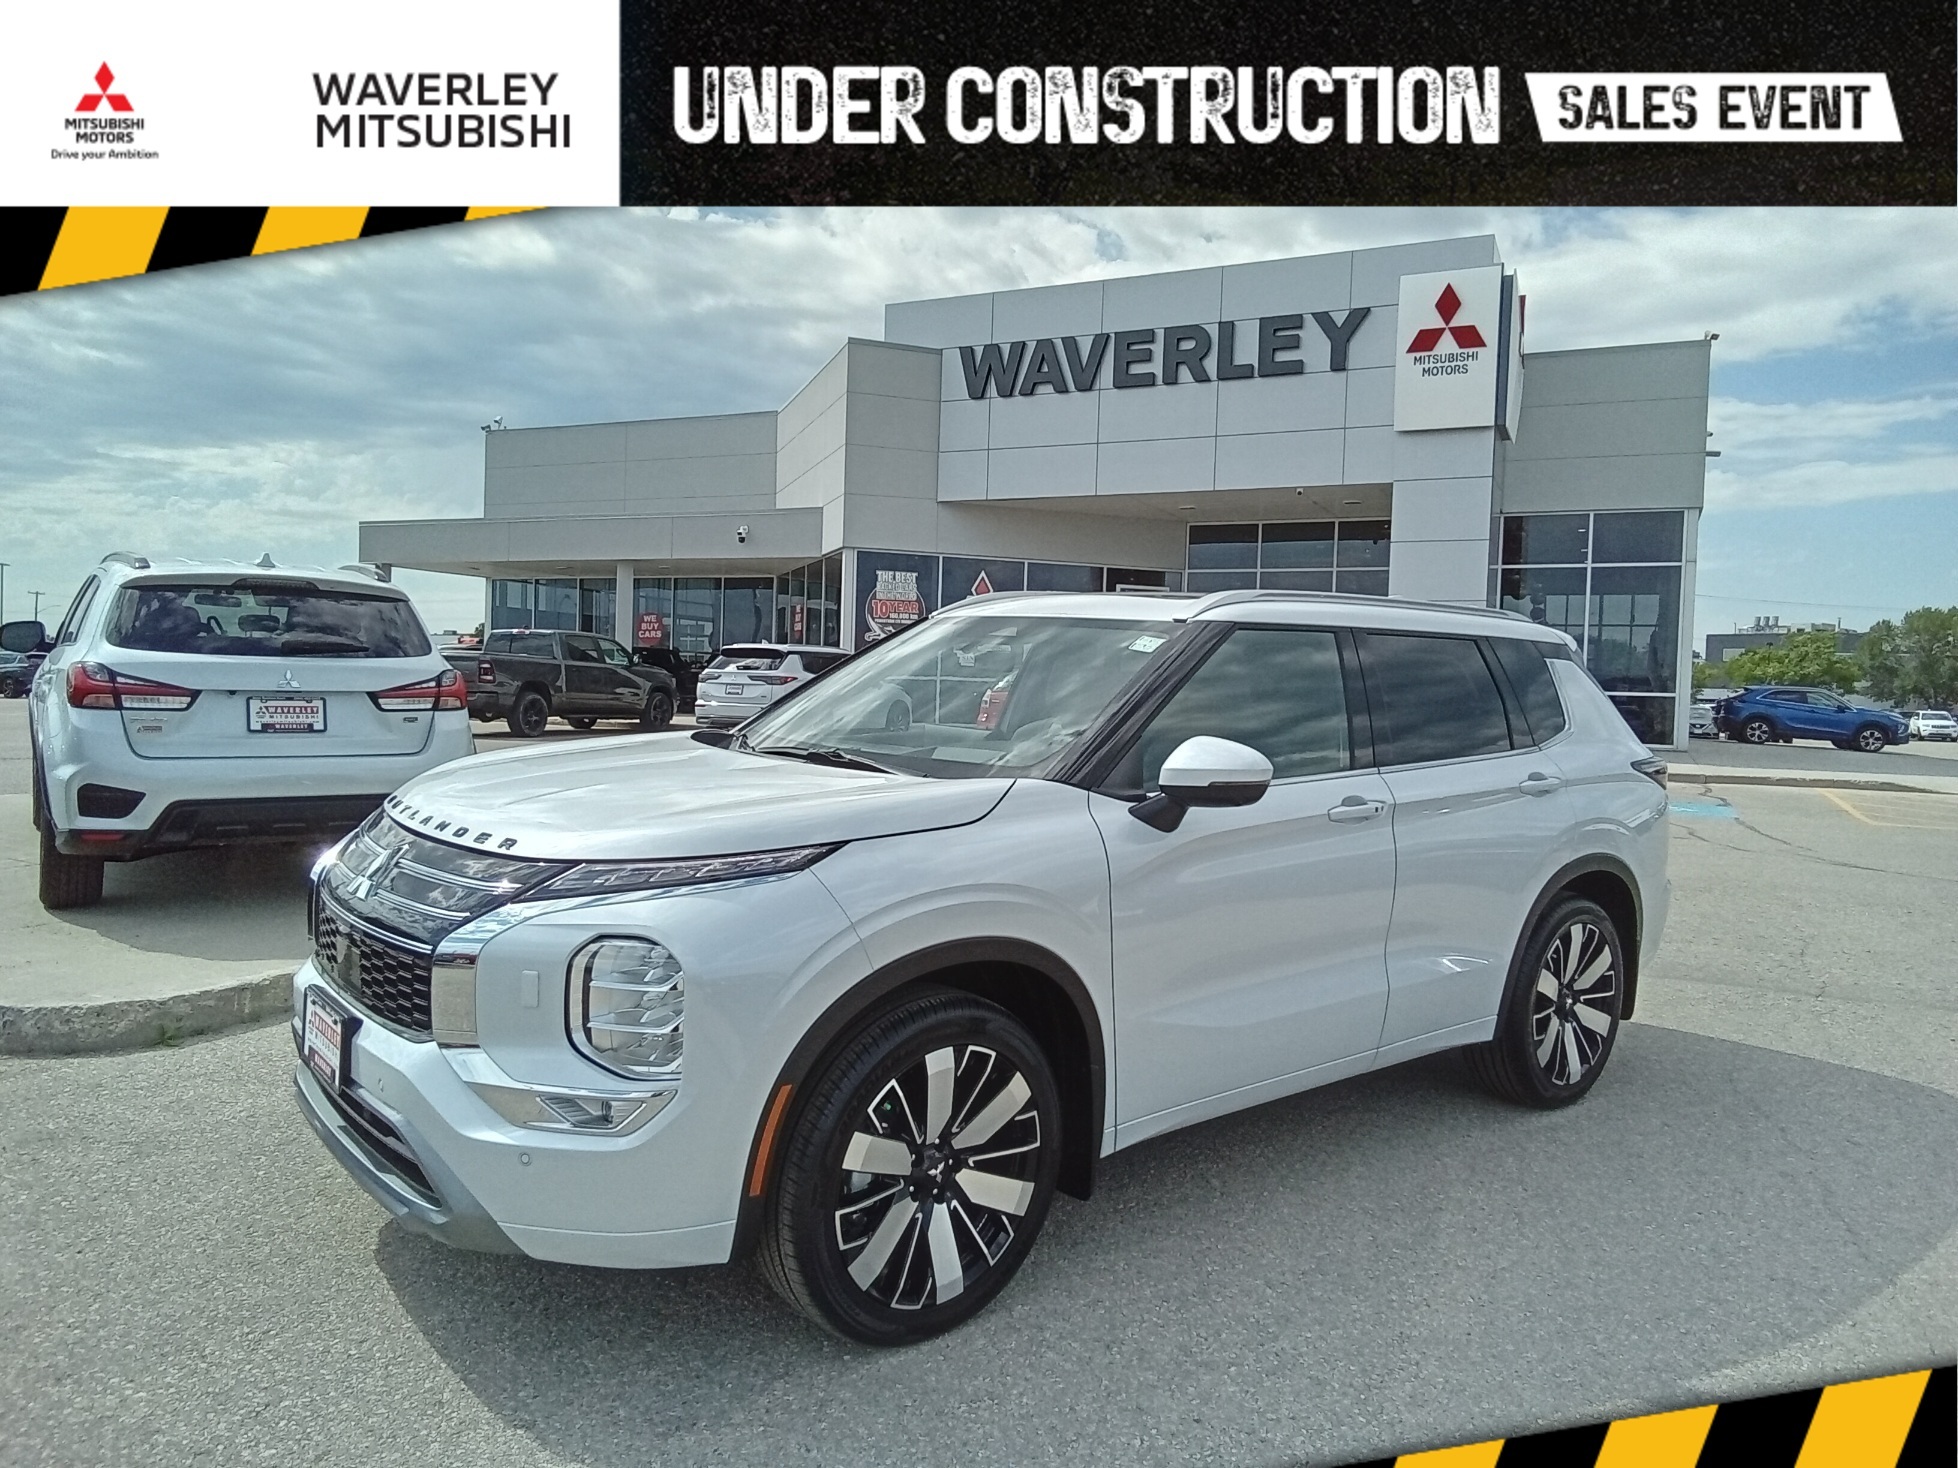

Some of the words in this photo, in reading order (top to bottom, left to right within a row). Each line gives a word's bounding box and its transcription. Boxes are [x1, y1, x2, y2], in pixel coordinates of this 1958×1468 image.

[959, 308, 1371, 399] WAVERLEY
[1413, 351, 1479, 366] MITSUBISHI
[1422, 364, 1469, 377] MOTORS
[876, 570, 895, 582] THE
[895, 571, 918, 583] BEST
[872, 600, 889, 618] 10
[889, 601, 919, 613] YEAR
[387, 794, 518, 851] OUTLANDER
